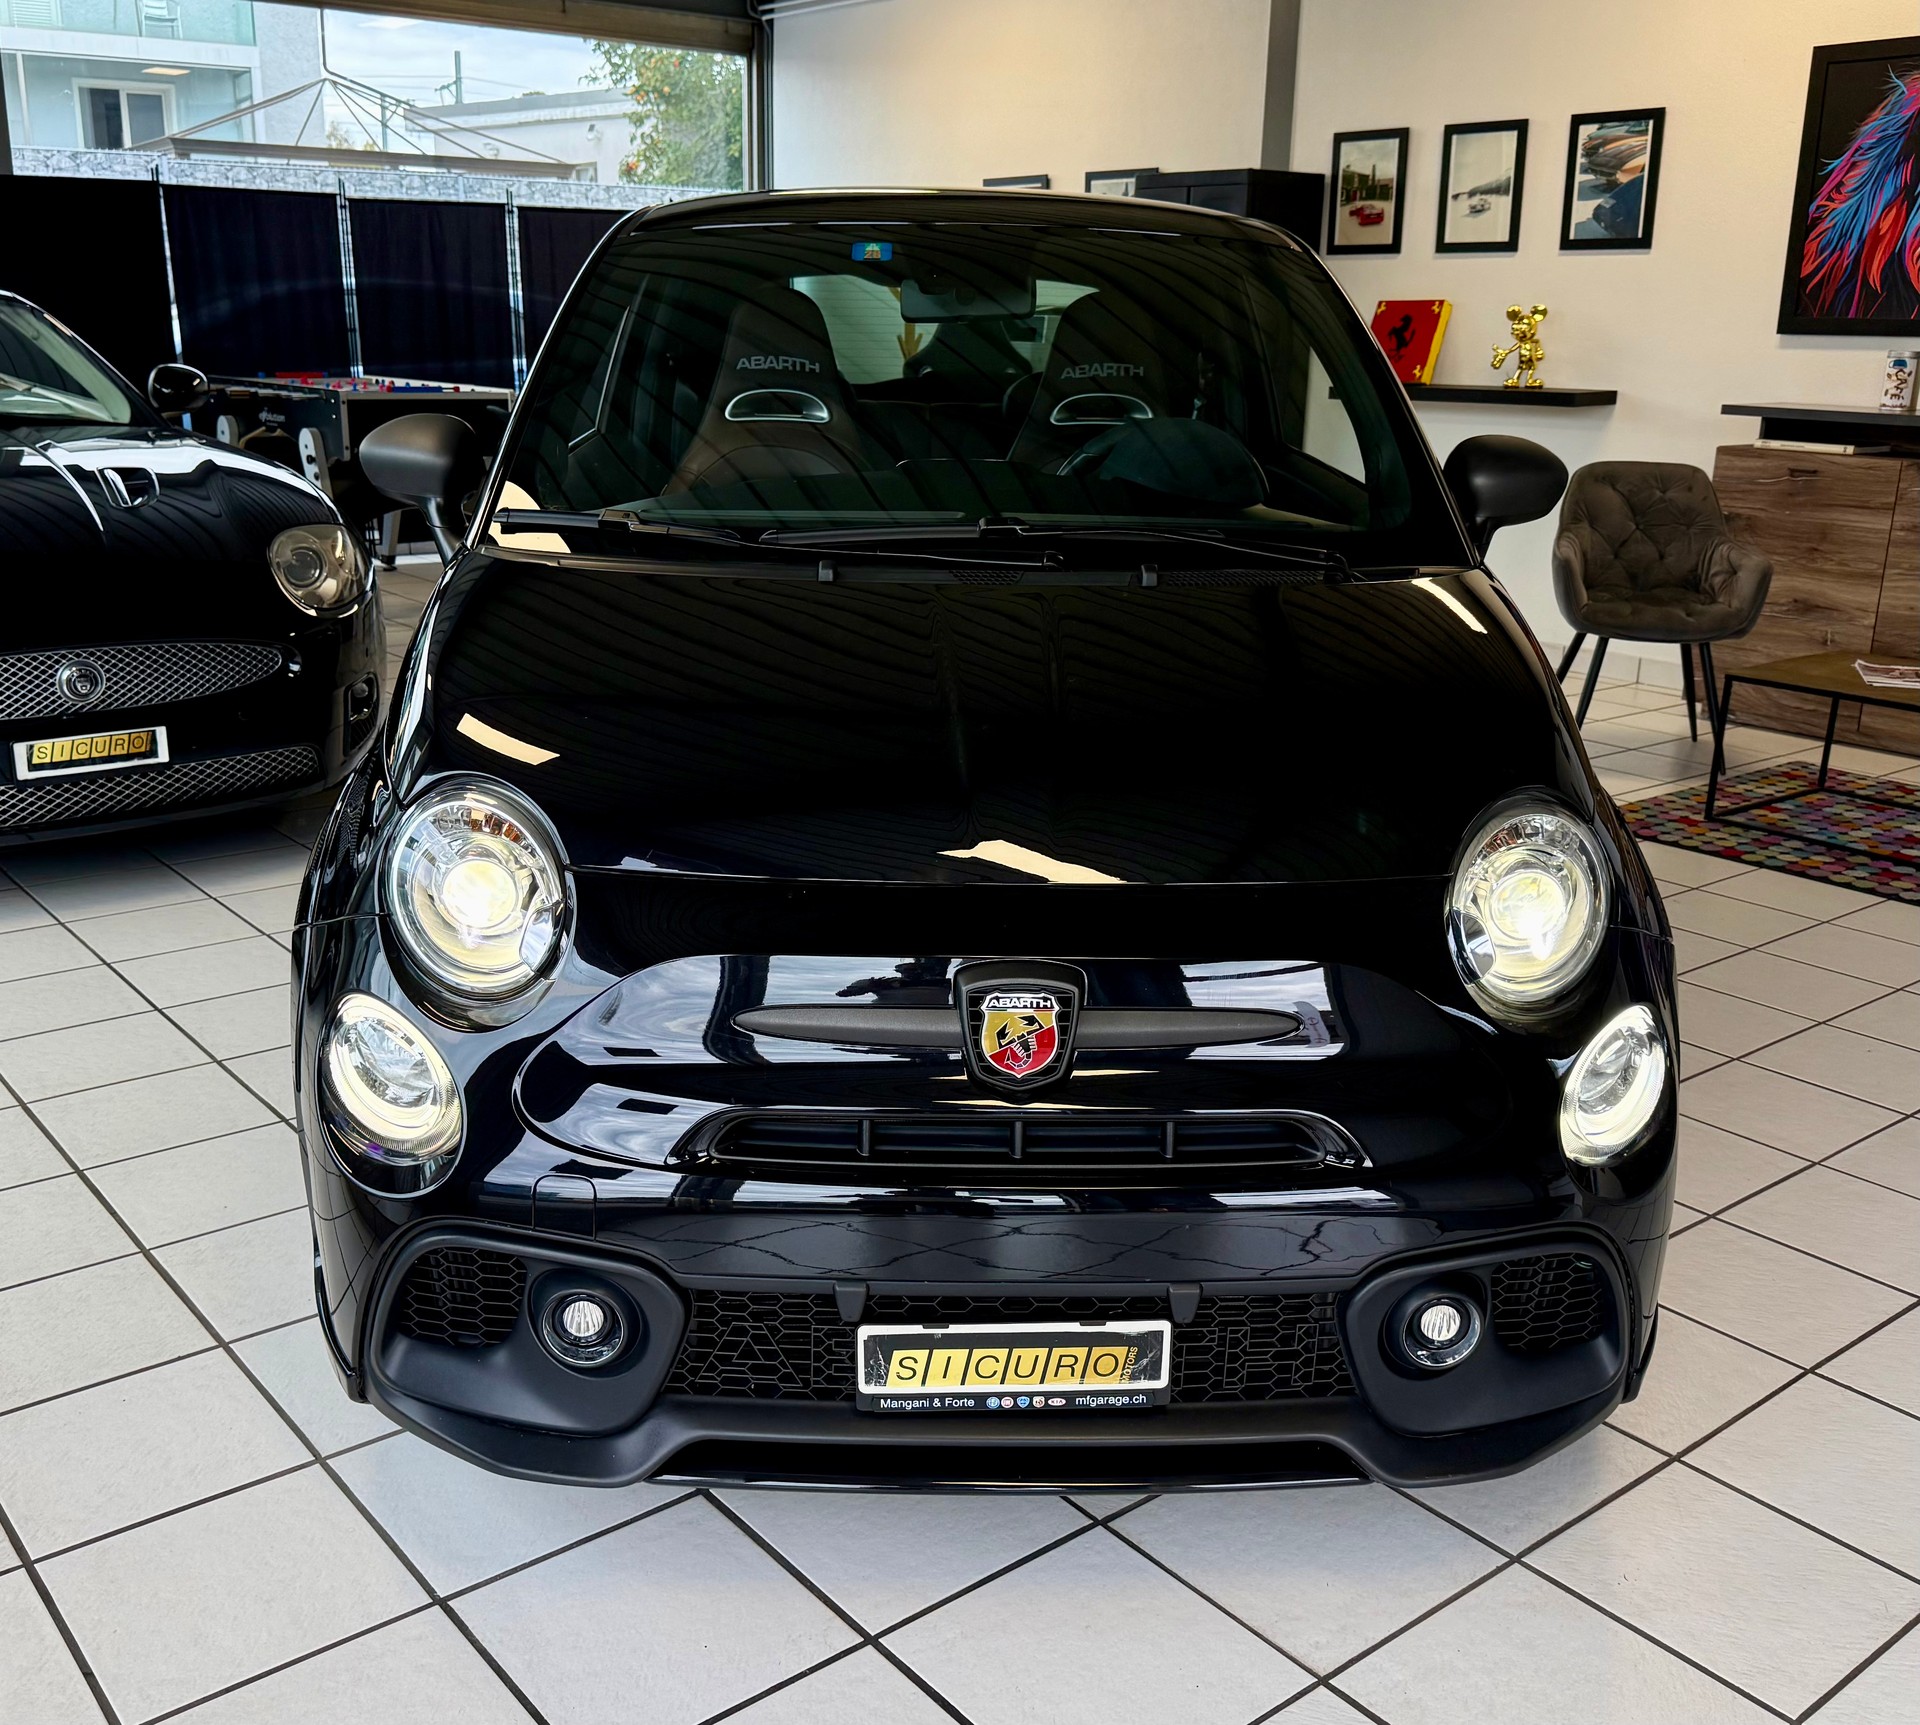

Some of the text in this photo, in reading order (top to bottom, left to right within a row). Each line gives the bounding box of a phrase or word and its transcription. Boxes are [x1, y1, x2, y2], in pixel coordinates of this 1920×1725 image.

[736, 355, 820, 373] ABARTH
[1061, 362, 1144, 379] ABARTH
[36, 735, 144, 760] SICURO
[987, 998, 1051, 1008] ABARTH
[895, 1352, 1120, 1381] SICURO
[1121, 1346, 1138, 1382] MOTORS
[880, 1397, 975, 1410] Mangani & Forte
[1075, 1394, 1147, 1407] mfgarage.ch
